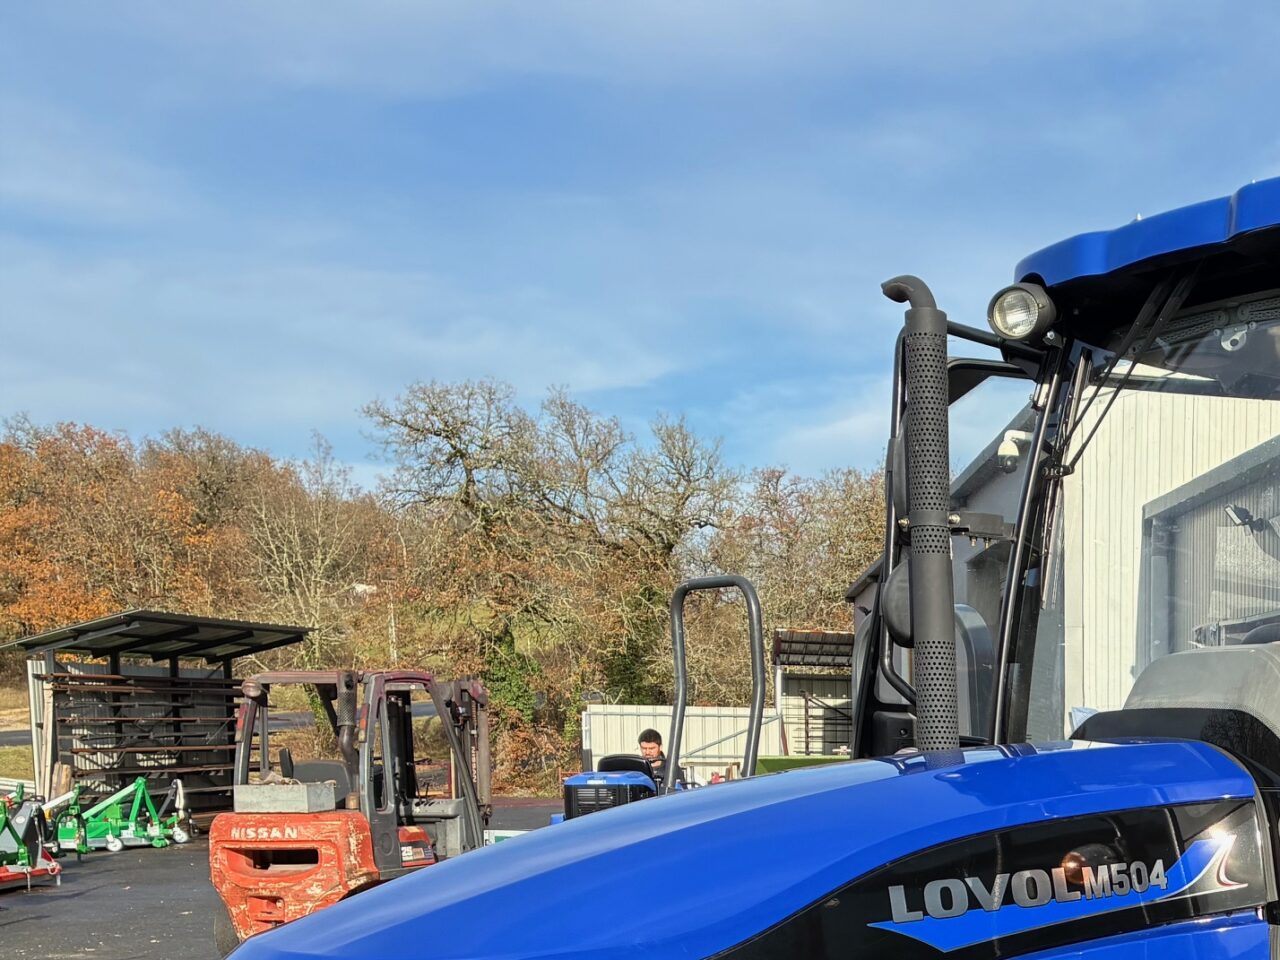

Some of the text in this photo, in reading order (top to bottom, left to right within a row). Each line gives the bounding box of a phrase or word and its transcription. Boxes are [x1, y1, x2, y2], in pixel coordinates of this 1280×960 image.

[231, 826, 298, 839] NISSAN
[888, 858, 1168, 923] LOVOL M504
